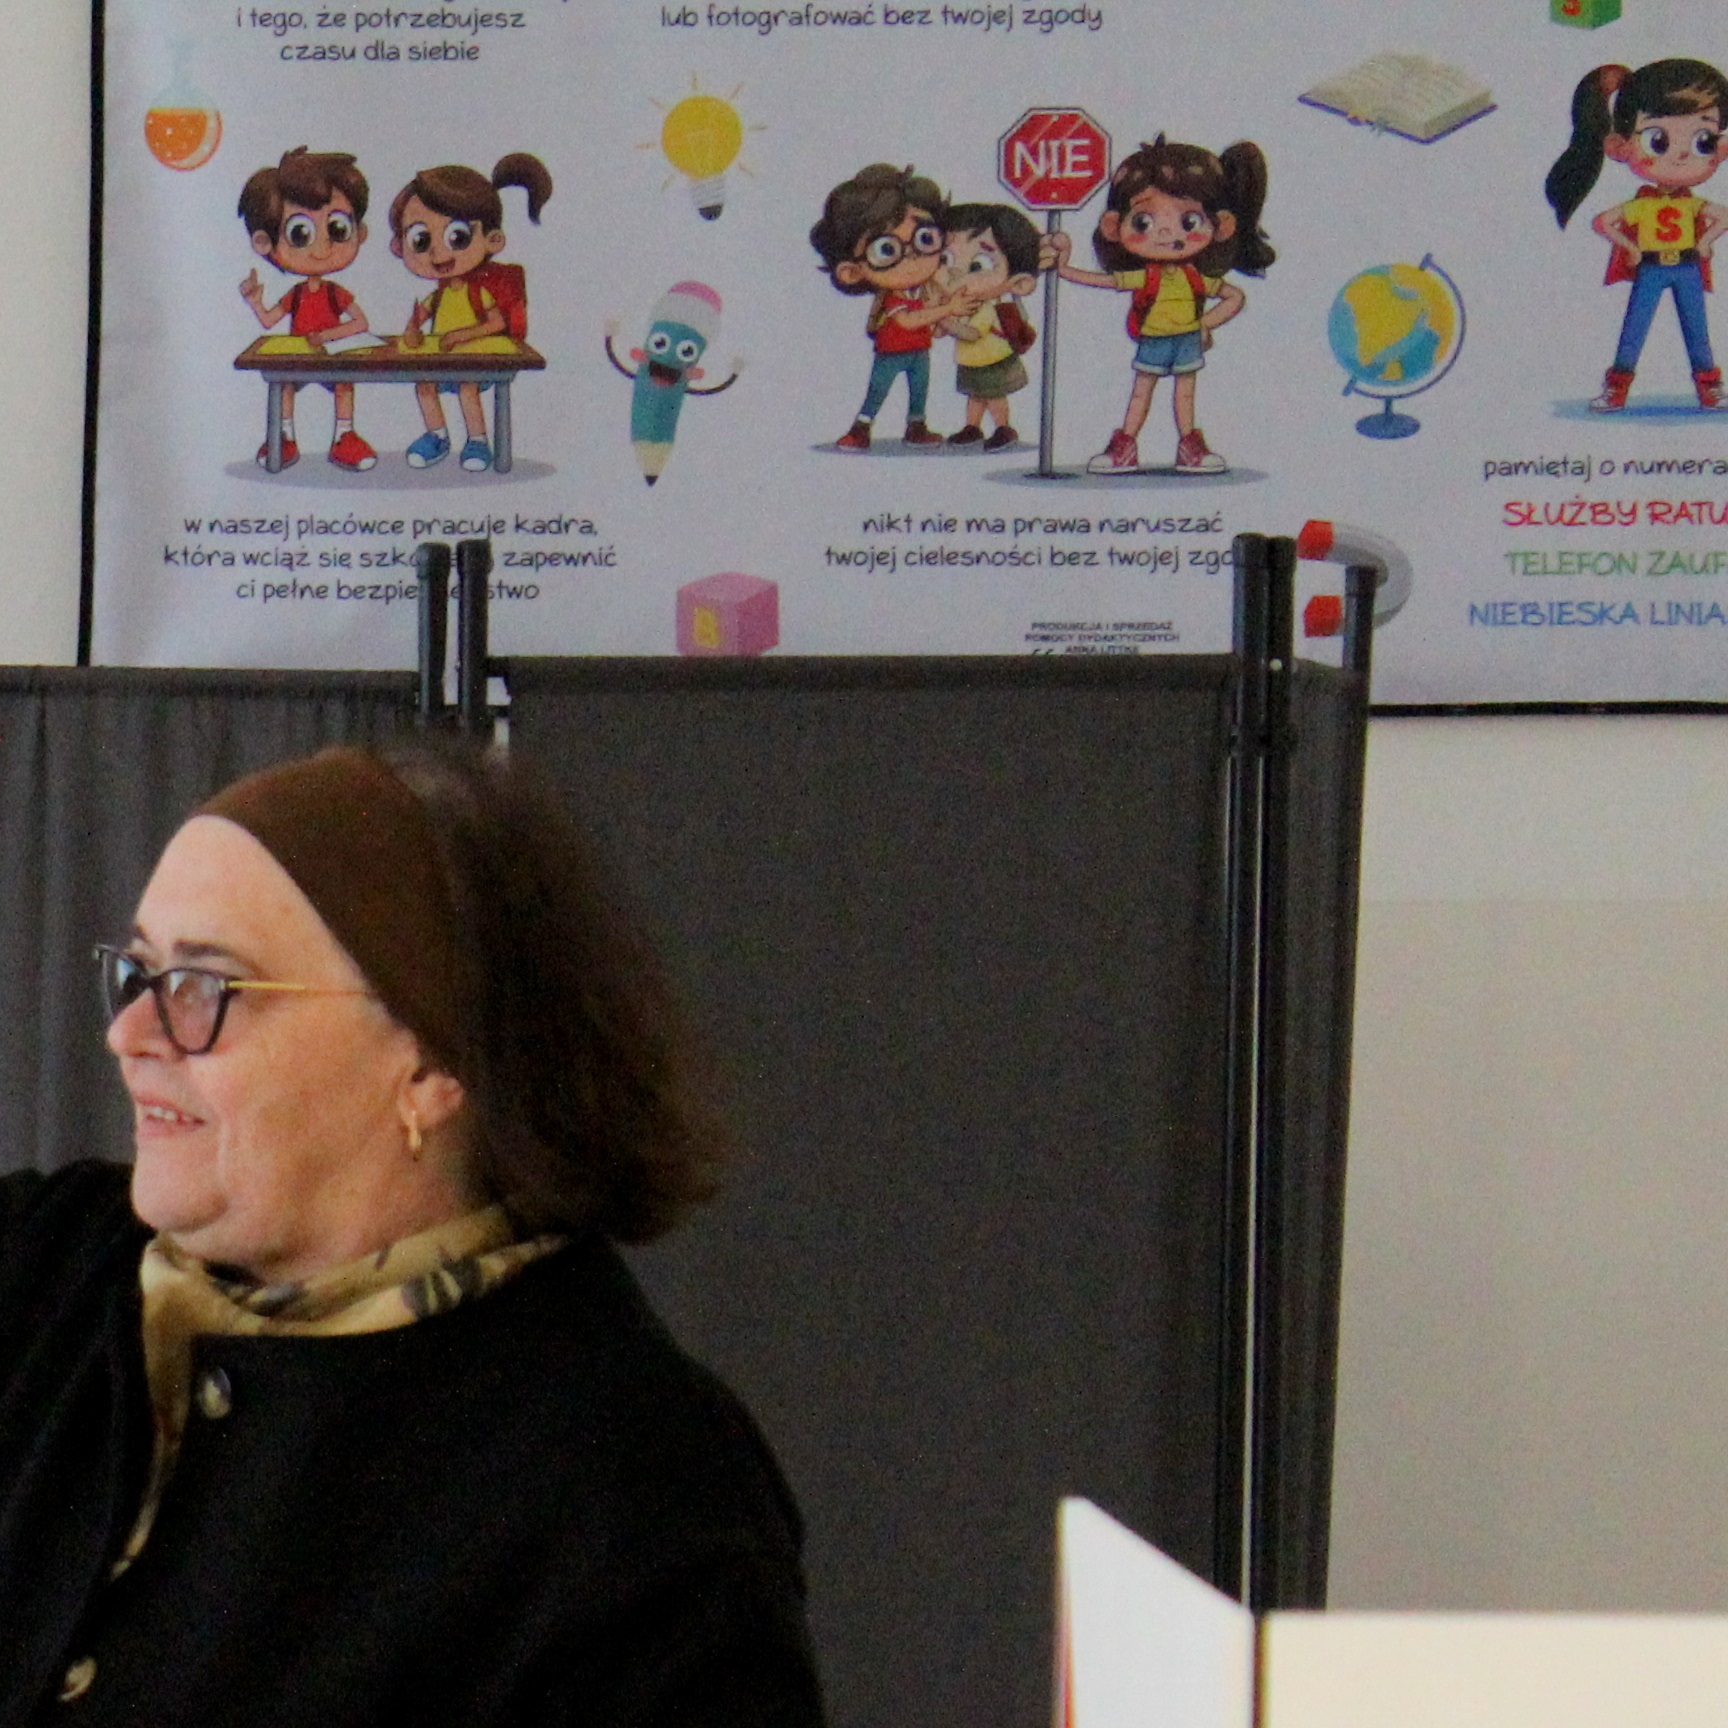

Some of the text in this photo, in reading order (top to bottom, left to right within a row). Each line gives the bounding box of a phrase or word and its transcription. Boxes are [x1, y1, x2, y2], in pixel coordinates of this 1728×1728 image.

[237, 8, 243, 28] i
[316, 5, 347, 28] że
[354, 7, 527, 37] potrzebujesz
[660, 3, 1103, 35] lub fotografować bez twojej zgody
[280, 39, 480, 62] czasu dla siebie
[1014, 138, 1094, 180] NIE
[1655, 206, 1683, 242] S
[1484, 455, 1591, 482] pamiętaj
[1599, 459, 1615, 475] o
[862, 510, 1223, 538] nikt nie ma prawa naruszać
[1503, 495, 1638, 526] SŁUŻBY
[184, 512, 598, 542] w naszej placówce pracuje kadra,
[164, 545, 236, 567] która
[244, 545, 311, 572] wciąż
[319, 546, 352, 570] się
[503, 545, 618, 572] zapewnić
[825, 545, 897, 573] twojej
[904, 544, 1043, 566] cielesności
[1050, 545, 1100, 566] bez
[1107, 545, 1180, 573] twojej
[1506, 551, 1639, 576] TELEFON
[236, 579, 255, 599] ci
[263, 579, 329, 603] pełne
[1469, 602, 1641, 628] NIEBIESKA
